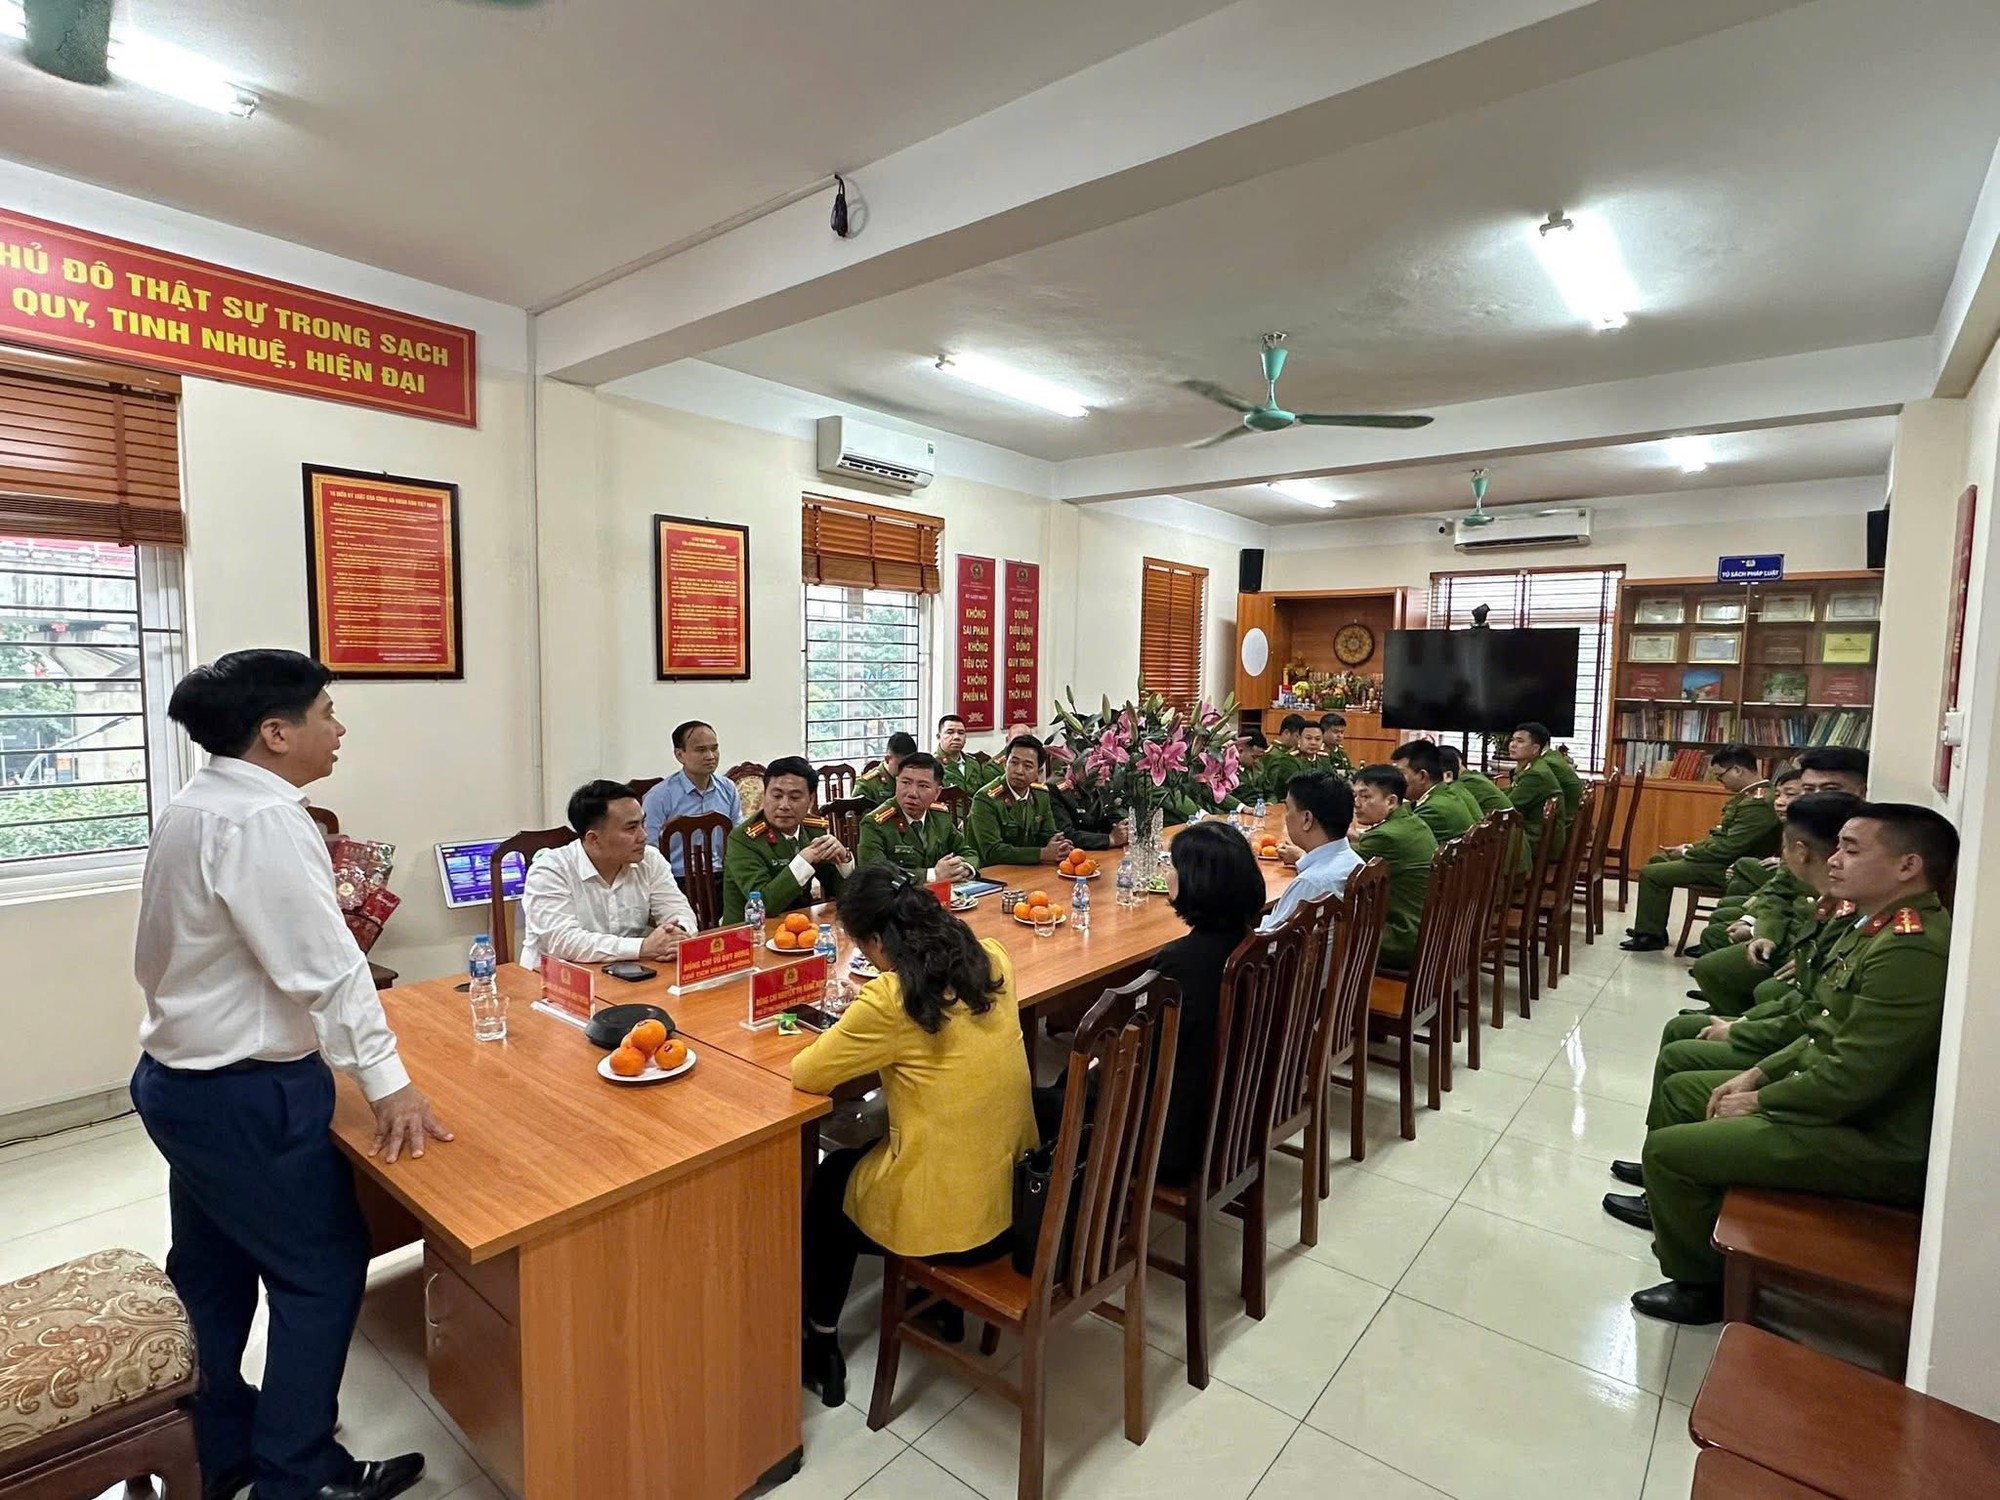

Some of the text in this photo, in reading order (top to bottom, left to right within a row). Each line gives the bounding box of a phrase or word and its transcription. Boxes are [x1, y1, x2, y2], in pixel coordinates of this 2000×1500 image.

[12, 287, 425, 394] QUY, TINH NHUỆ, HIỆN ĐẠI
[62, 257, 114, 290] ĐÔ
[126, 272, 211, 311] THẬT
[222, 296, 268, 328] SỰ
[274, 307, 370, 348] TRONG
[379, 333, 448, 367] SẠCH
